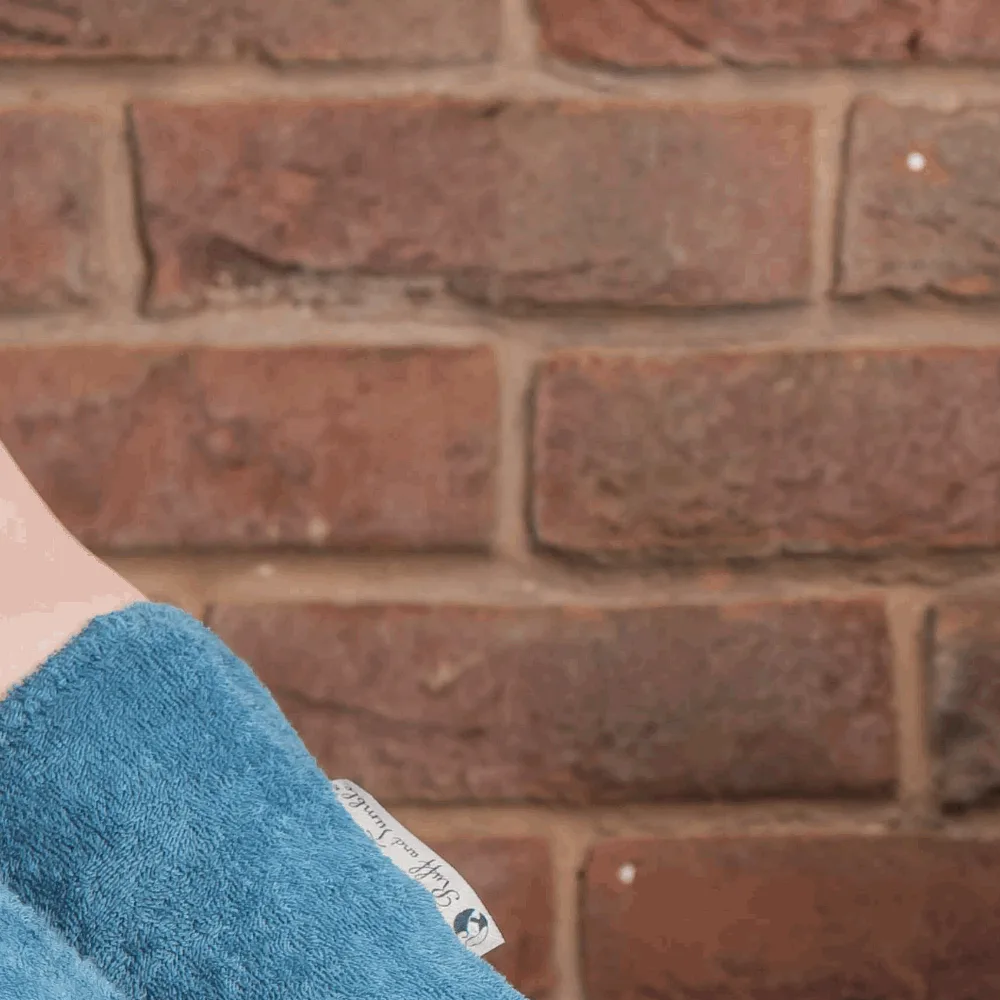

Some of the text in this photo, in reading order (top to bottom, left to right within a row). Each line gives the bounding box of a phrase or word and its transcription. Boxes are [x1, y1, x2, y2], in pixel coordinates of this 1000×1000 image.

[341, 783, 460, 908] Ruff and Tumble
